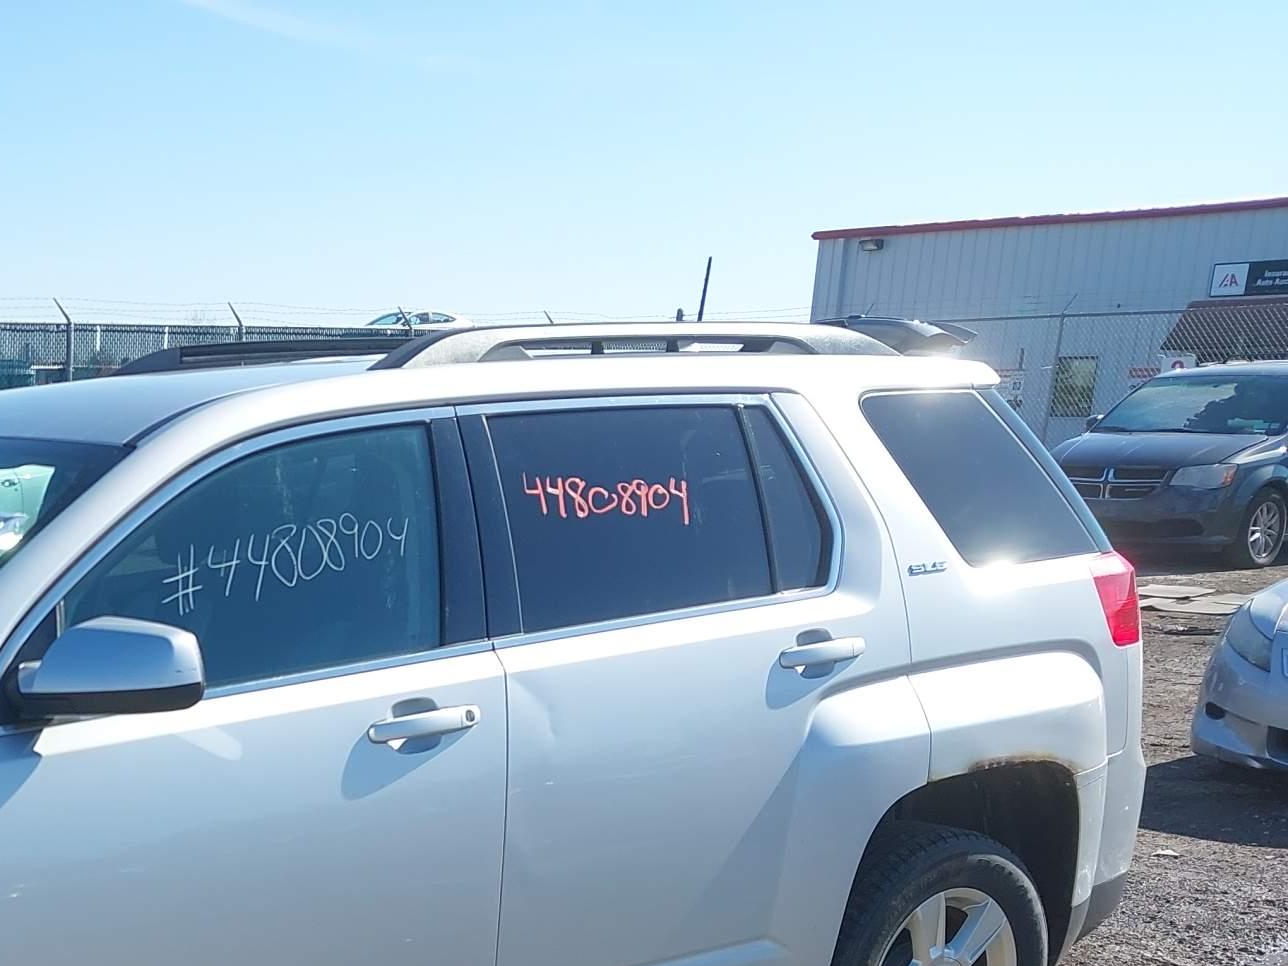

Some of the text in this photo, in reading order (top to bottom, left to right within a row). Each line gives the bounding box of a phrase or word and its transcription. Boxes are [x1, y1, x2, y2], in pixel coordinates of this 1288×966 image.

[522, 471, 690, 526] 44808904
[161, 512, 409, 616] #44808904
[907, 560, 948, 577] SLE
